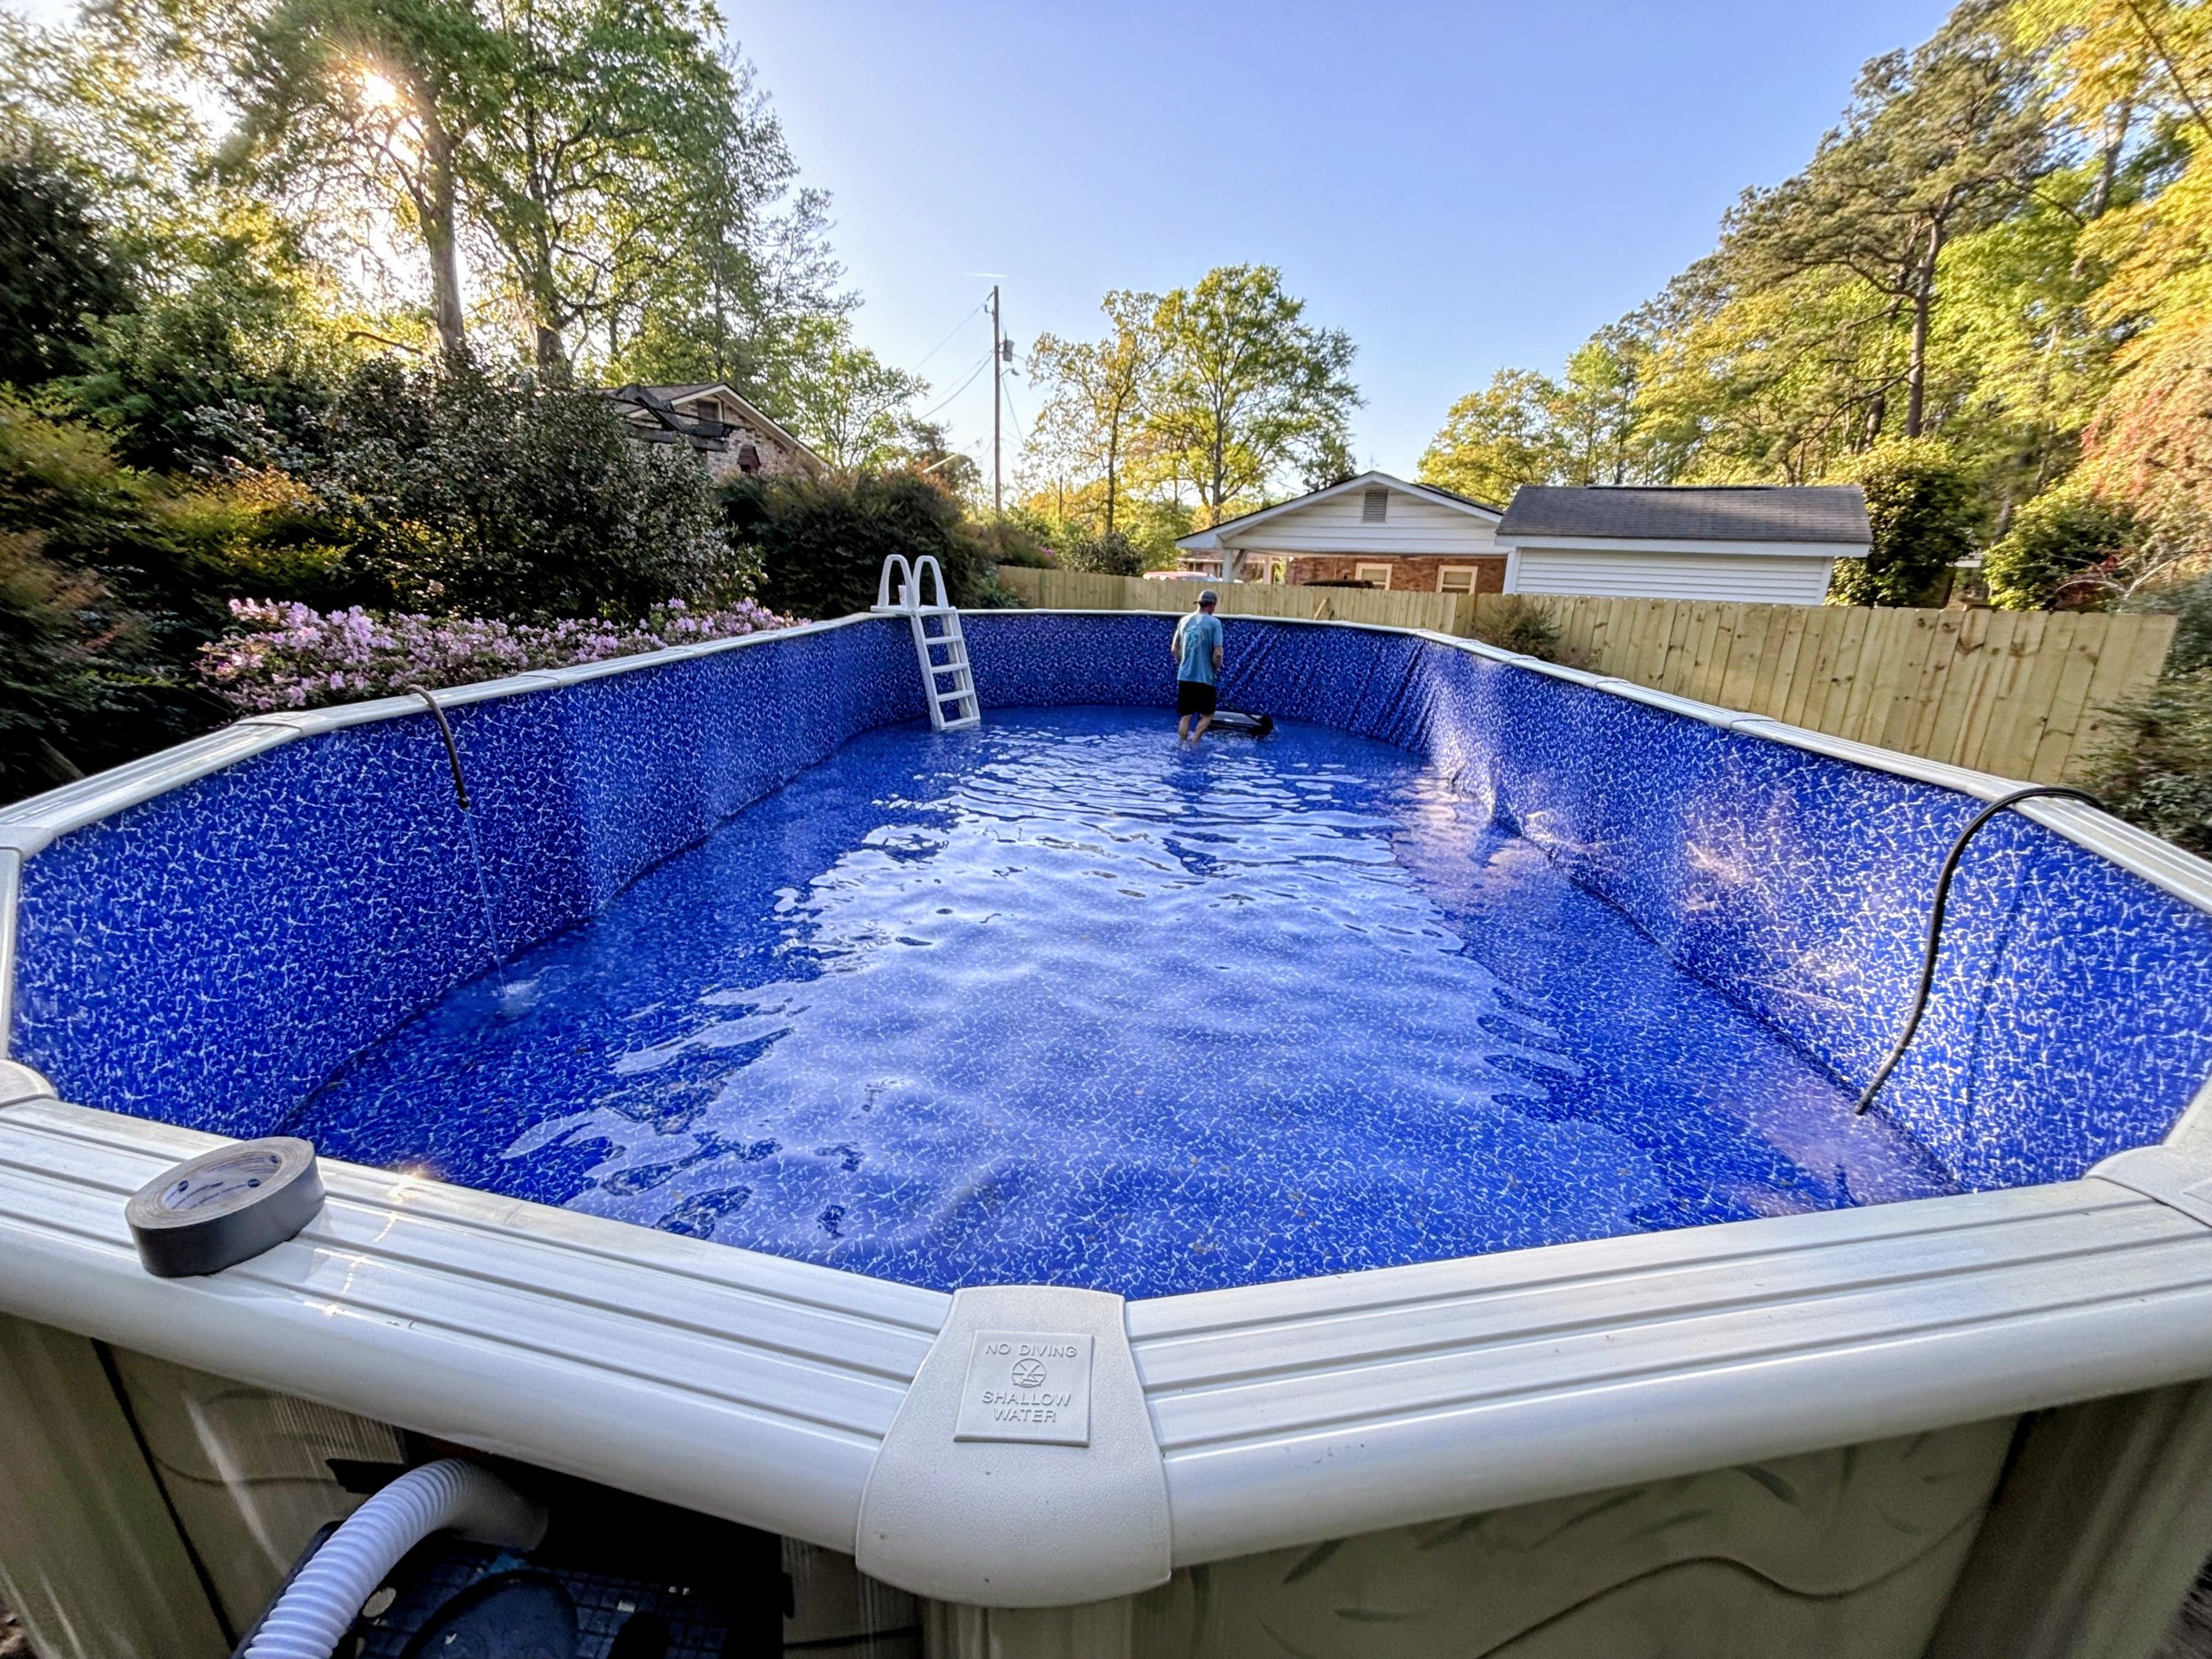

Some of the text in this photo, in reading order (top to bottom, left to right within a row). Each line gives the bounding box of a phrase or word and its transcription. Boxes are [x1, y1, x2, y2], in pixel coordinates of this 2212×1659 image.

[986, 1343, 1077, 1358] NO DIVING
[982, 1390, 1071, 1407] SHALLOW
[994, 1408, 1056, 1423] WATER
